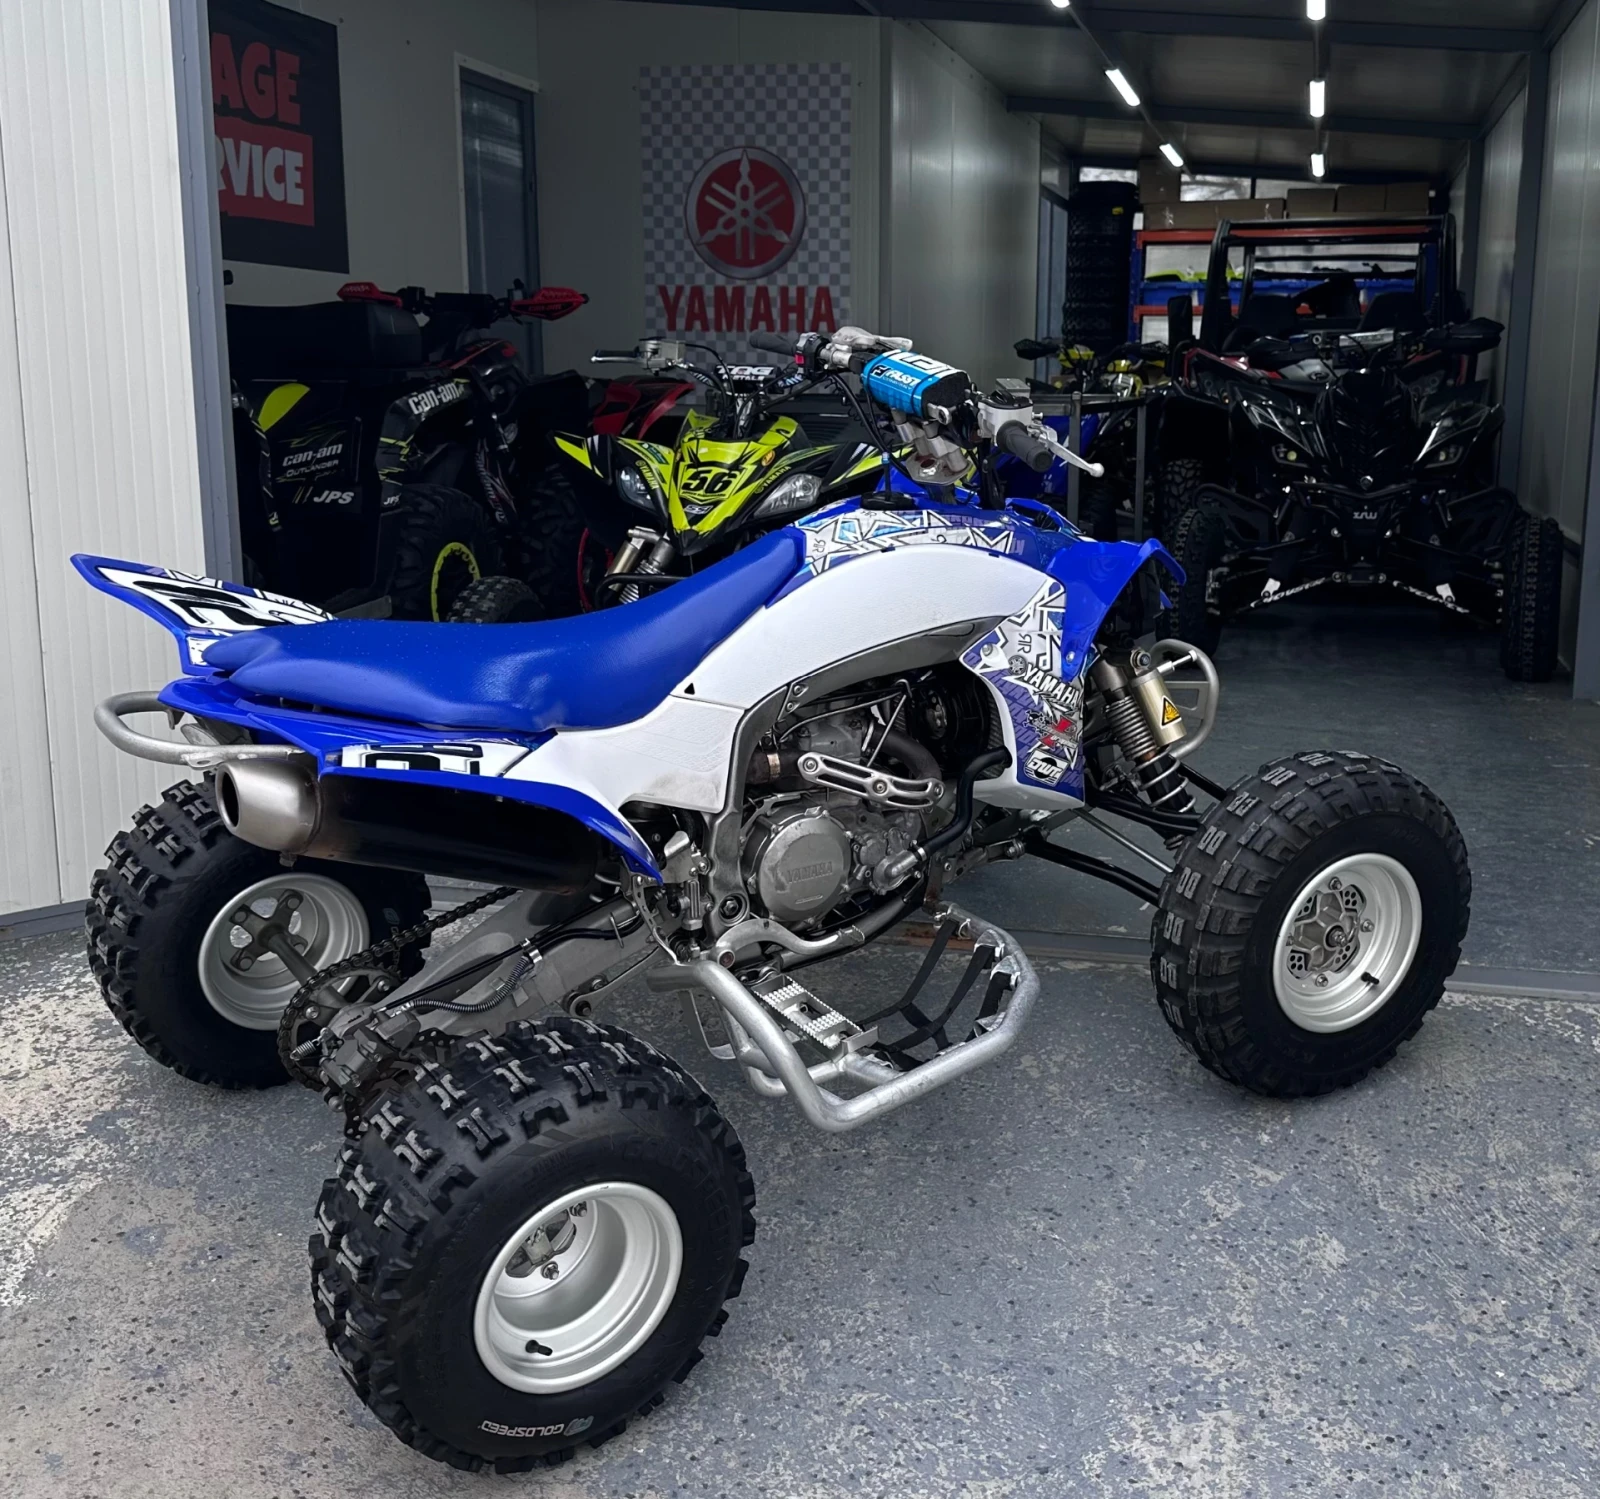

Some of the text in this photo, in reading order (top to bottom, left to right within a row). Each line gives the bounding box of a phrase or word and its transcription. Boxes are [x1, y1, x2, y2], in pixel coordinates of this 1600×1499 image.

[211, 32, 301, 126] AGE
[657, 284, 838, 334] YAMAHA
[716, 365, 775, 376] TAG
[884, 367, 921, 387] FASST
[407, 382, 460, 416] can-am
[282, 443, 344, 468] can-am
[639, 464, 660, 490] YAMAHA
[681, 466, 738, 494] 56
[762, 465, 793, 487] YAMAHA
[312, 489, 356, 505] JPS
[1023, 662, 1082, 709] YAMAHA
[1027, 757, 1063, 779] DWT
[786, 861, 834, 884] YAMAHA
[480, 1420, 565, 1438] GOLDSPEED
